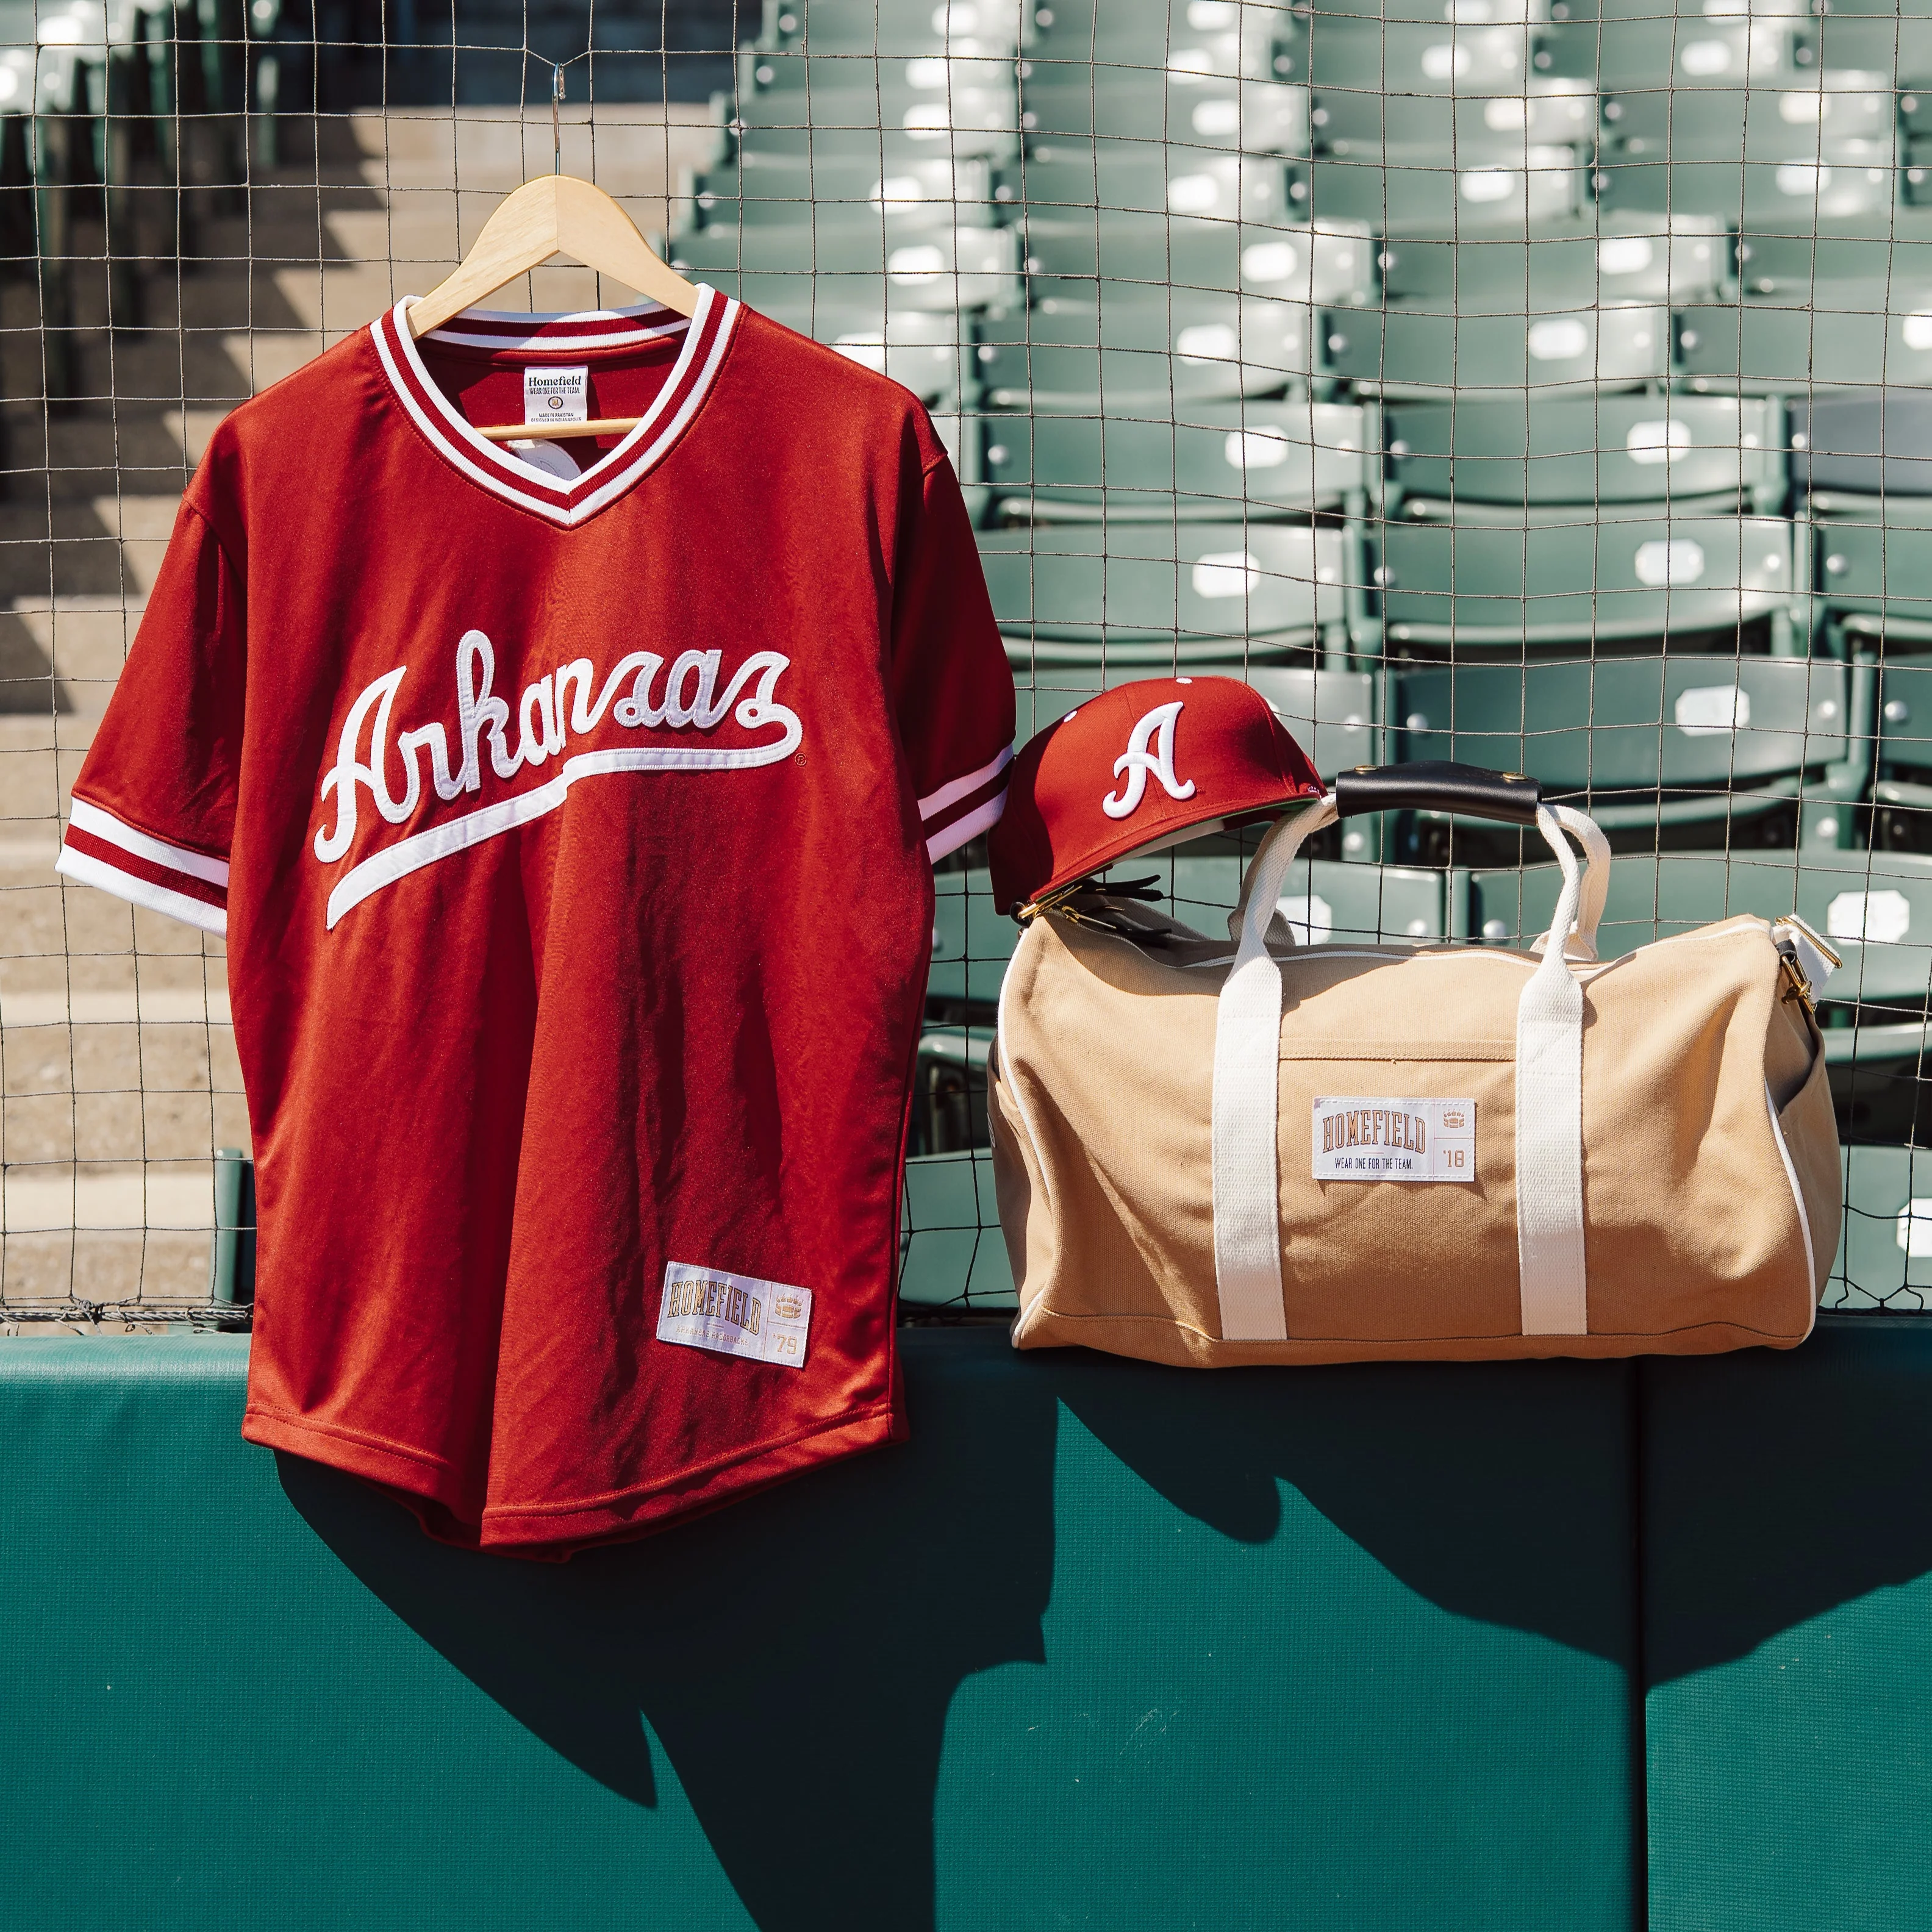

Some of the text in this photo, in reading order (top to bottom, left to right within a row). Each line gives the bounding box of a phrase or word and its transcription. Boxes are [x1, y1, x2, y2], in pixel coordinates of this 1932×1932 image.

[528, 376, 581, 387] Homefield
[313, 629, 803, 864] Arkansas
[1102, 700, 1195, 818] A
[1322, 1109, 1426, 1154] HOMEFIELD
[1334, 1157, 1414, 1170] WEAR ONE FOR THE TEAM.
[667, 1279, 762, 1336] HOMEFIELD
[711, 1331, 750, 1347] RAZORBACKS
